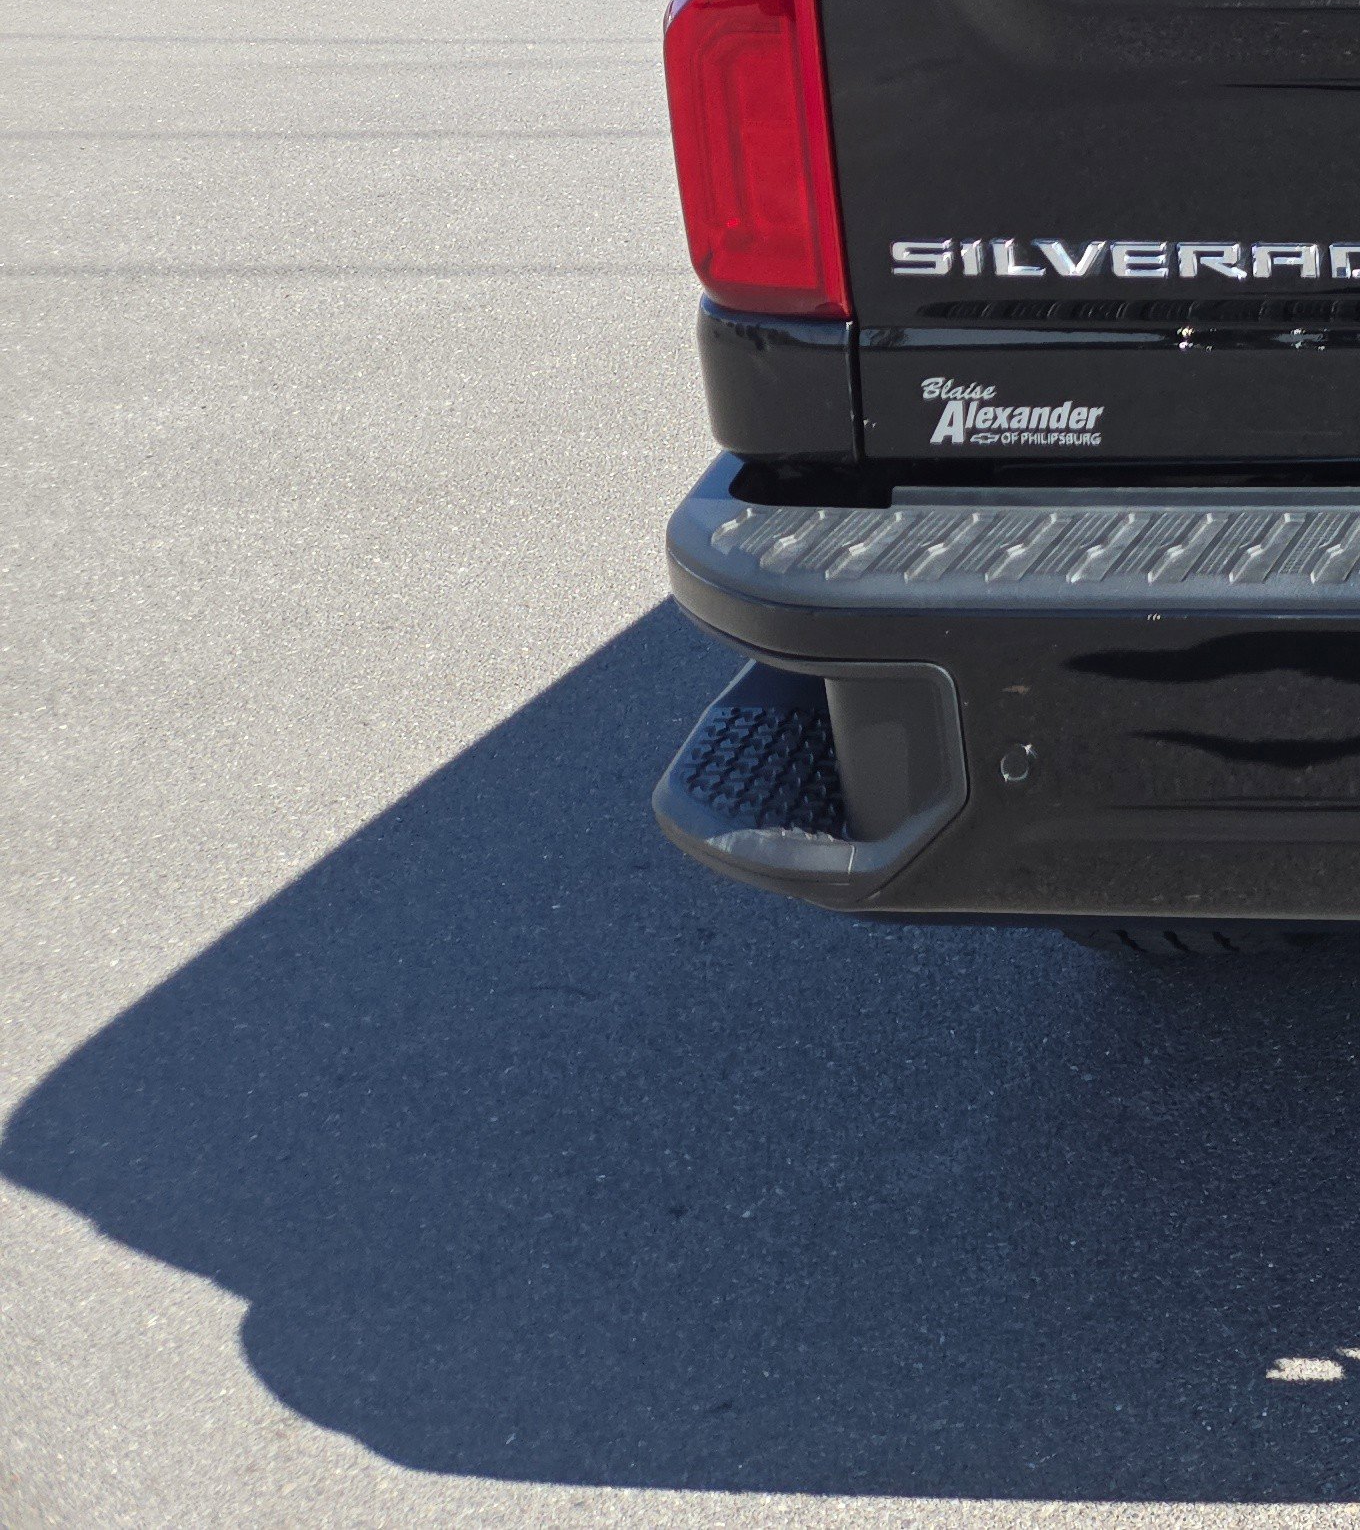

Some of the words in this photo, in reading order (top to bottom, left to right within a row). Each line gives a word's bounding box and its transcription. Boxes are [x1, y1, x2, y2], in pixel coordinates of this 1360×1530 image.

[921, 377, 996, 400] Blaise
[930, 400, 1105, 444] Alexander
[1001, 432, 1019, 445] OF
[1021, 432, 1102, 445] PHILIPSBURG
